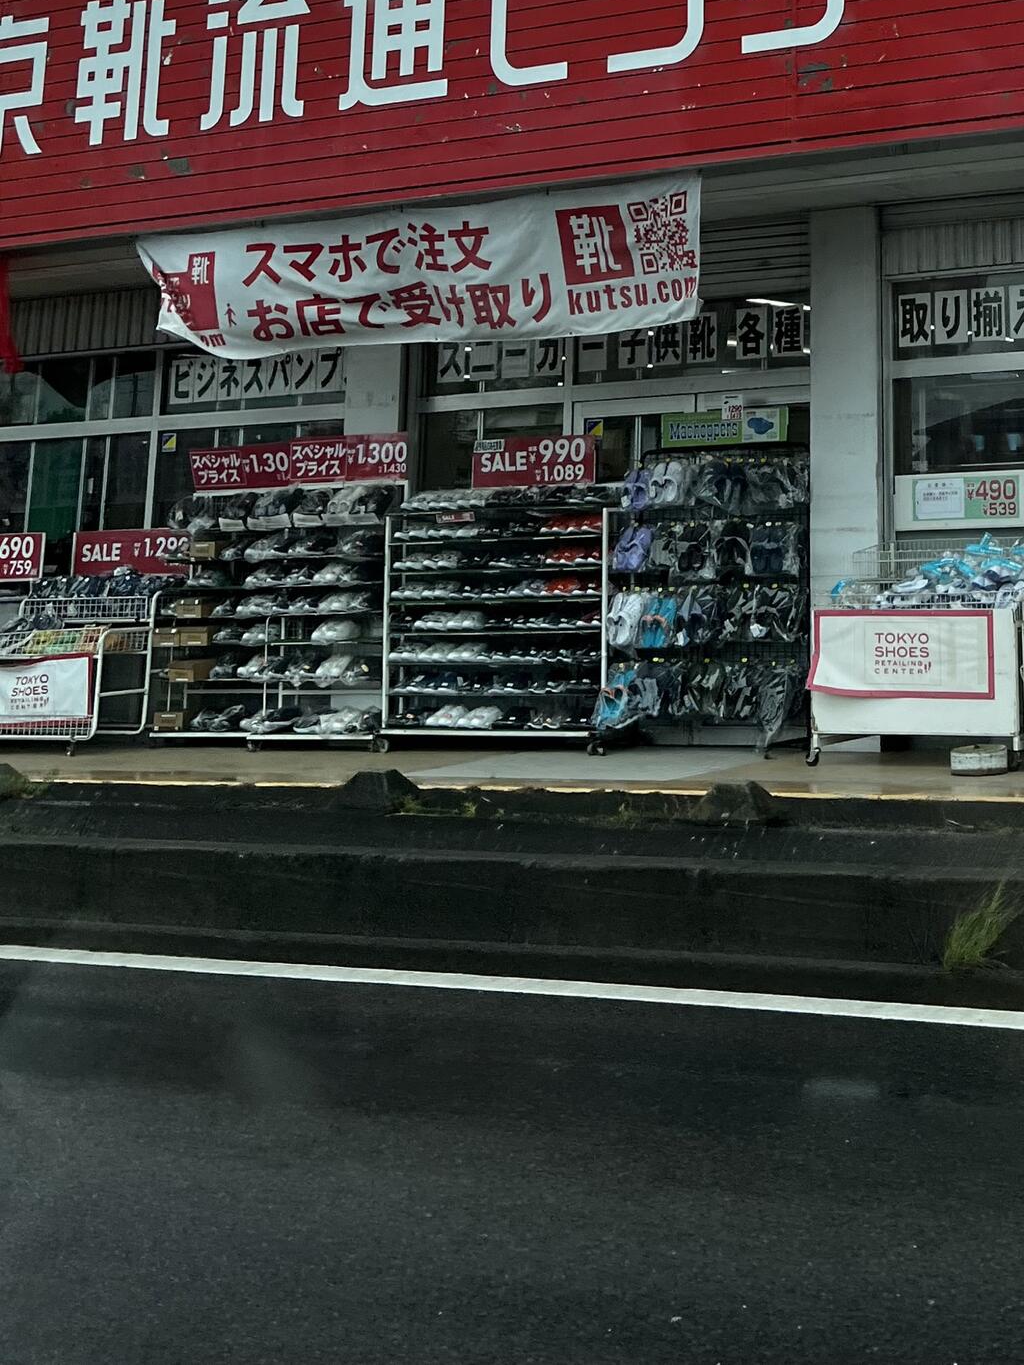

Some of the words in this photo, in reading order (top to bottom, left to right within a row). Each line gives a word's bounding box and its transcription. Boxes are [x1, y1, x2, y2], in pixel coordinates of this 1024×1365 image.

[569, 214, 623, 275] 靴
[242, 221, 492, 288] スマホで注文
[191, 256, 210, 285] 靴
[567, 275, 698, 316] kutsu.com
[246, 273, 552, 342] お店で受け取り
[174, 346, 347, 400] ビジネスパンプ
[192, 453, 241, 469] スペシャル
[292, 443, 346, 461] スペシャル
[296, 459, 341, 478] プライス
[481, 451, 528, 473] SALE
[198, 468, 241, 484] プライス
[81, 542, 122, 562] SALE
[874, 632, 930, 645] TOKYO
[874, 646, 930, 659] SHOES
[874, 667, 924, 675] CENTER
[875, 659, 924, 667] RETAILING
[15, 673, 49, 686] TOKYO
[11, 684, 49, 697] SHOES
